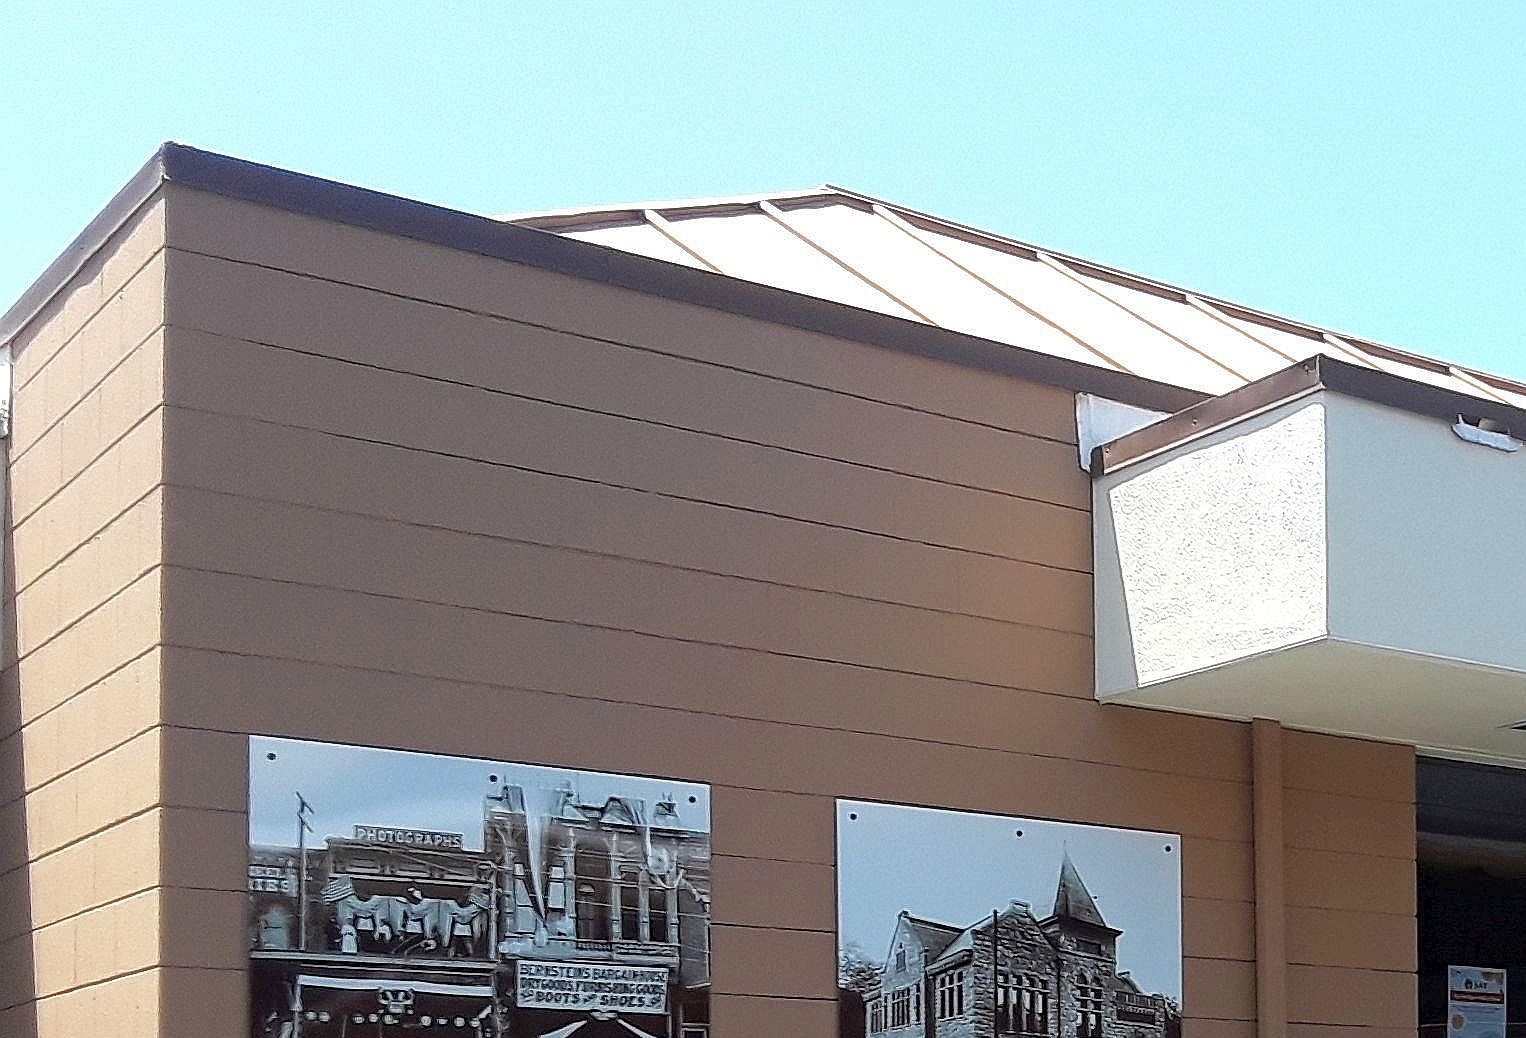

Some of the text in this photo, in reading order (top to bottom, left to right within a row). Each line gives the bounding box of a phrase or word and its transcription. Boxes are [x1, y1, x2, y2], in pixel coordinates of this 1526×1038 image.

[357, 827, 461, 848] PHOTOGRAPHS
[535, 991, 645, 1007] BOOTS SHOES
